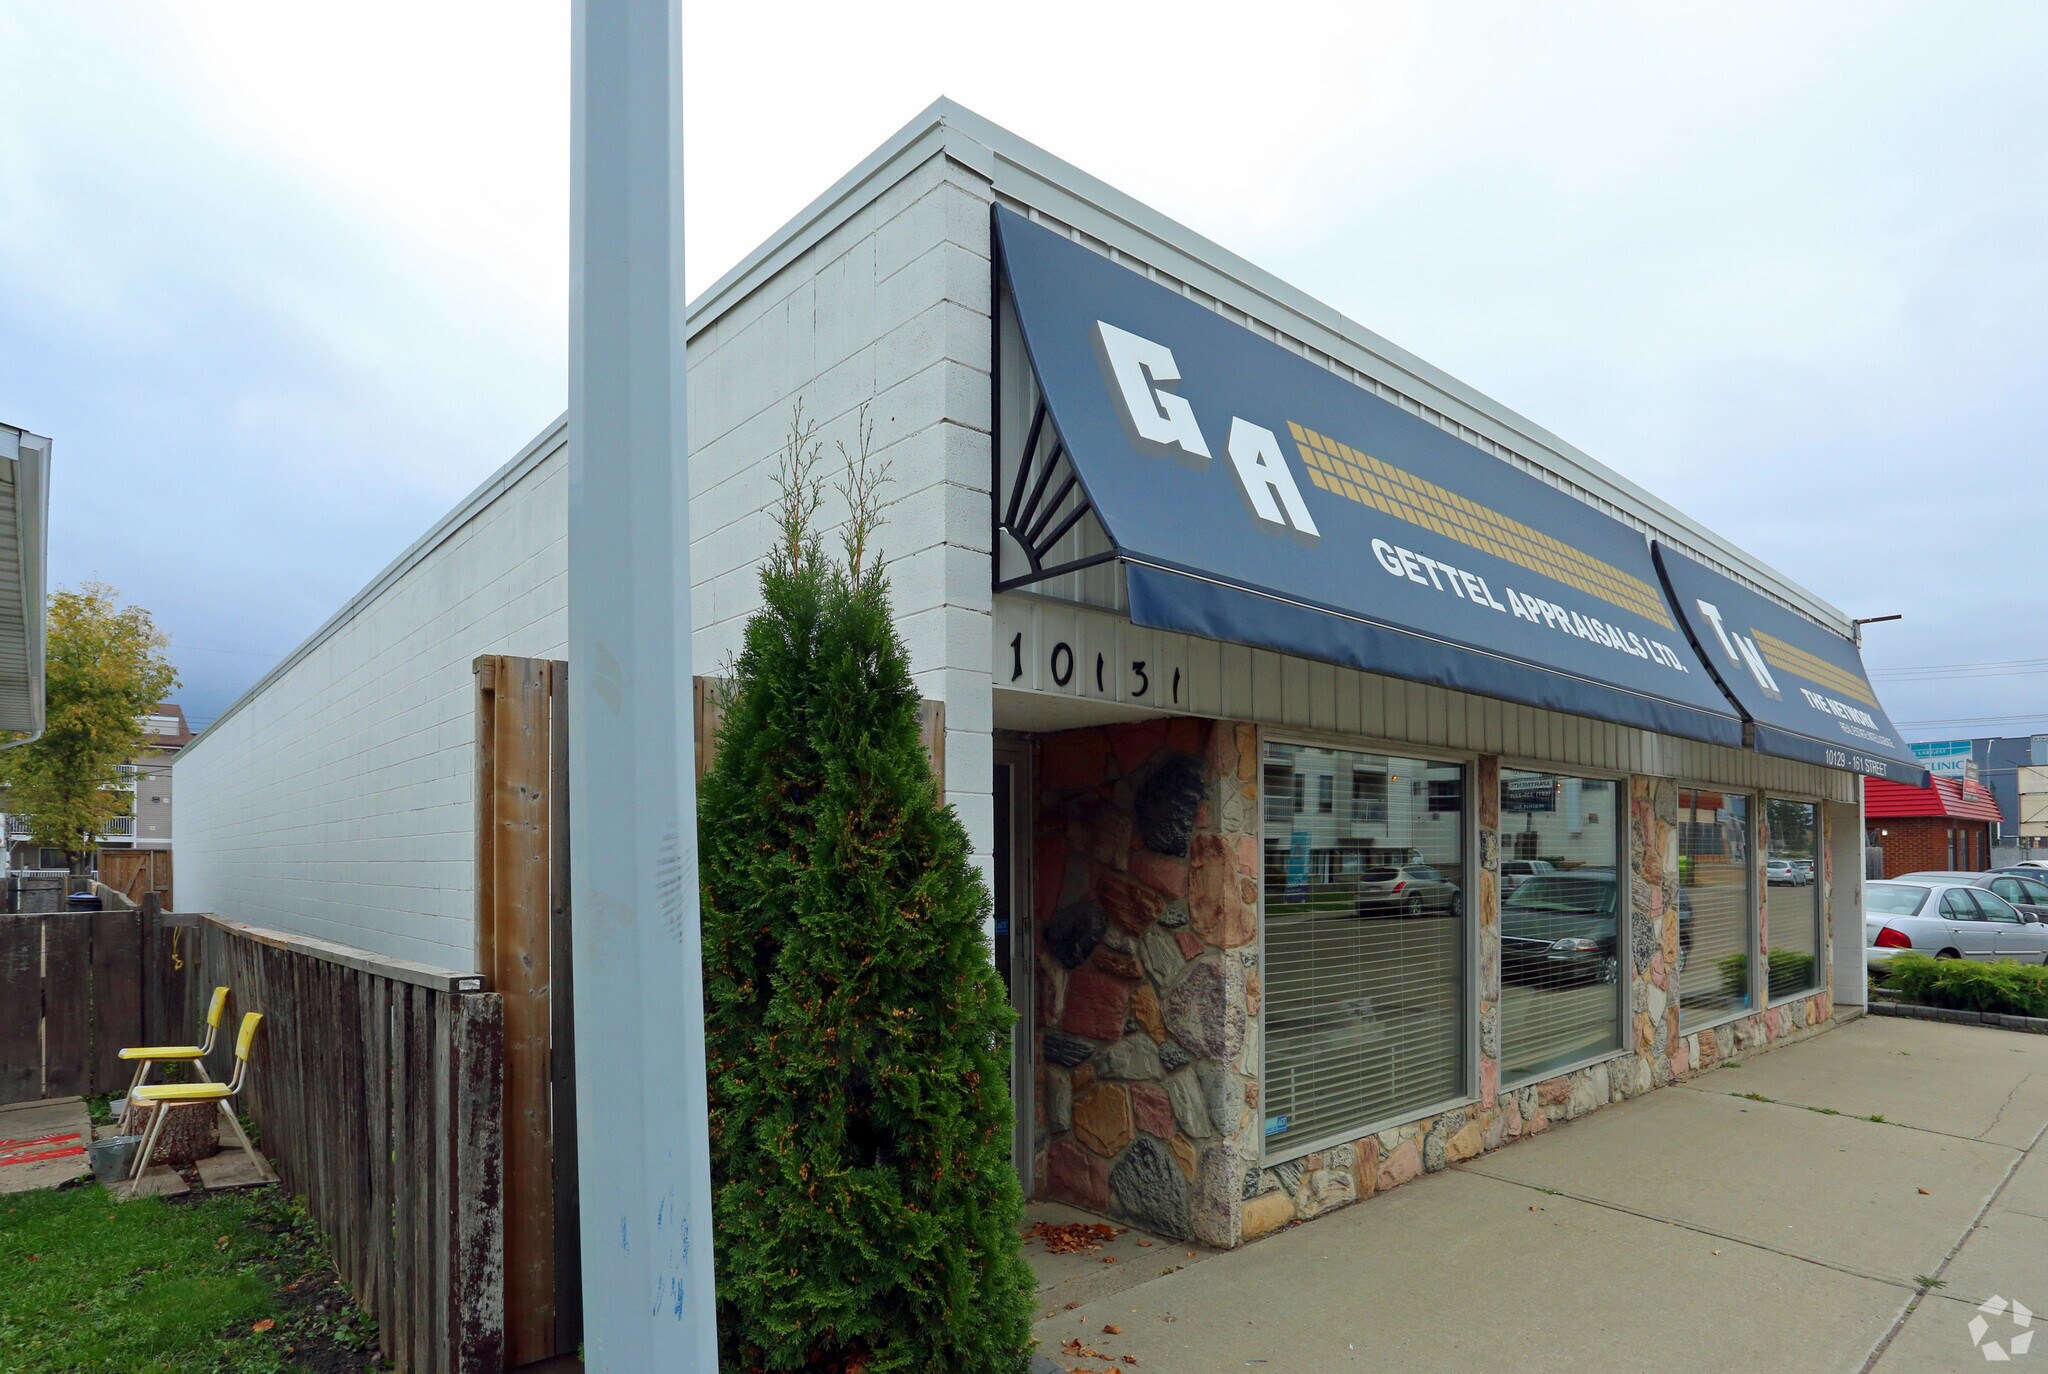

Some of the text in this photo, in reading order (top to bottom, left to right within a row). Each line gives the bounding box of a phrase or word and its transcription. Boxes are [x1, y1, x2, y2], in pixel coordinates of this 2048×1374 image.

[1371, 538, 1689, 673] GETTEL APPRAISALS LTD.
[1010, 632, 1180, 703] 10131
[1800, 688, 1879, 730] THE NETWORK
[1825, 749, 1846, 767] 10129
[1852, 756, 1864, 771] 161
[1864, 758, 1887, 777] STREET
